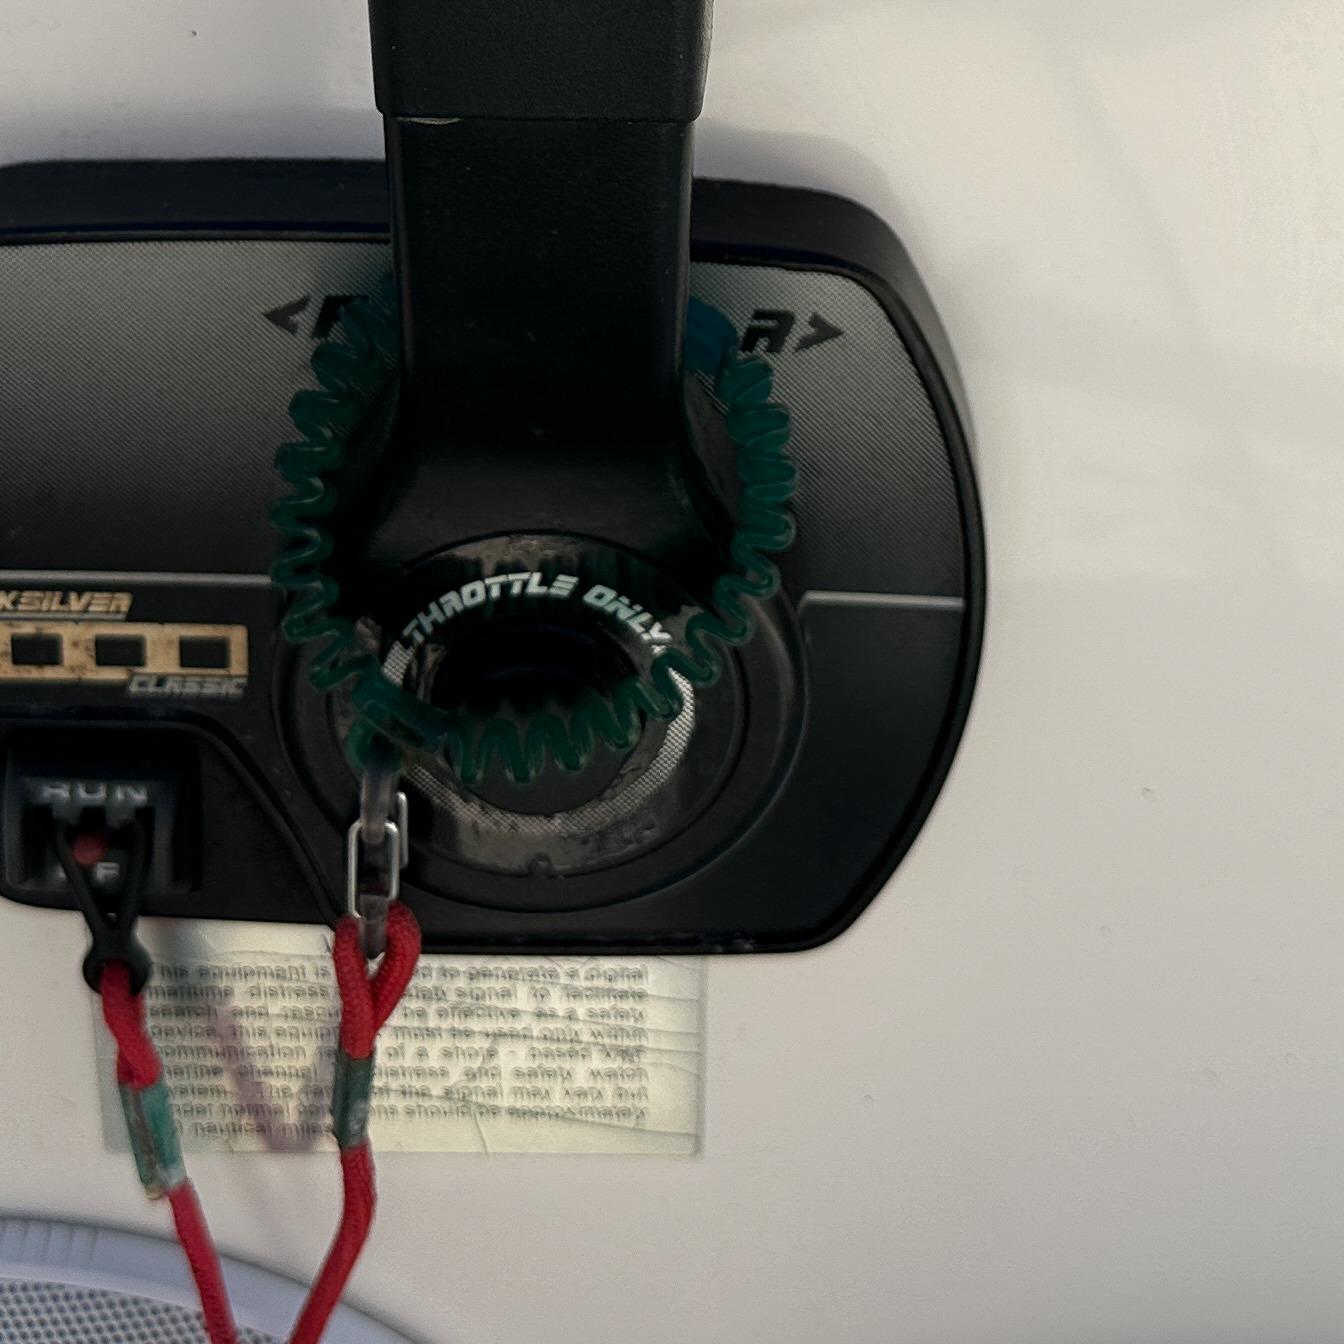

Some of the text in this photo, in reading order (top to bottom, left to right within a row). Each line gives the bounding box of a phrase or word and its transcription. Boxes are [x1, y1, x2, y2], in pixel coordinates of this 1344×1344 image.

[403, 571, 579, 645] THROTTLE
[128, 674, 248, 696] CLASSIC
[42, 782, 147, 802] RUN
